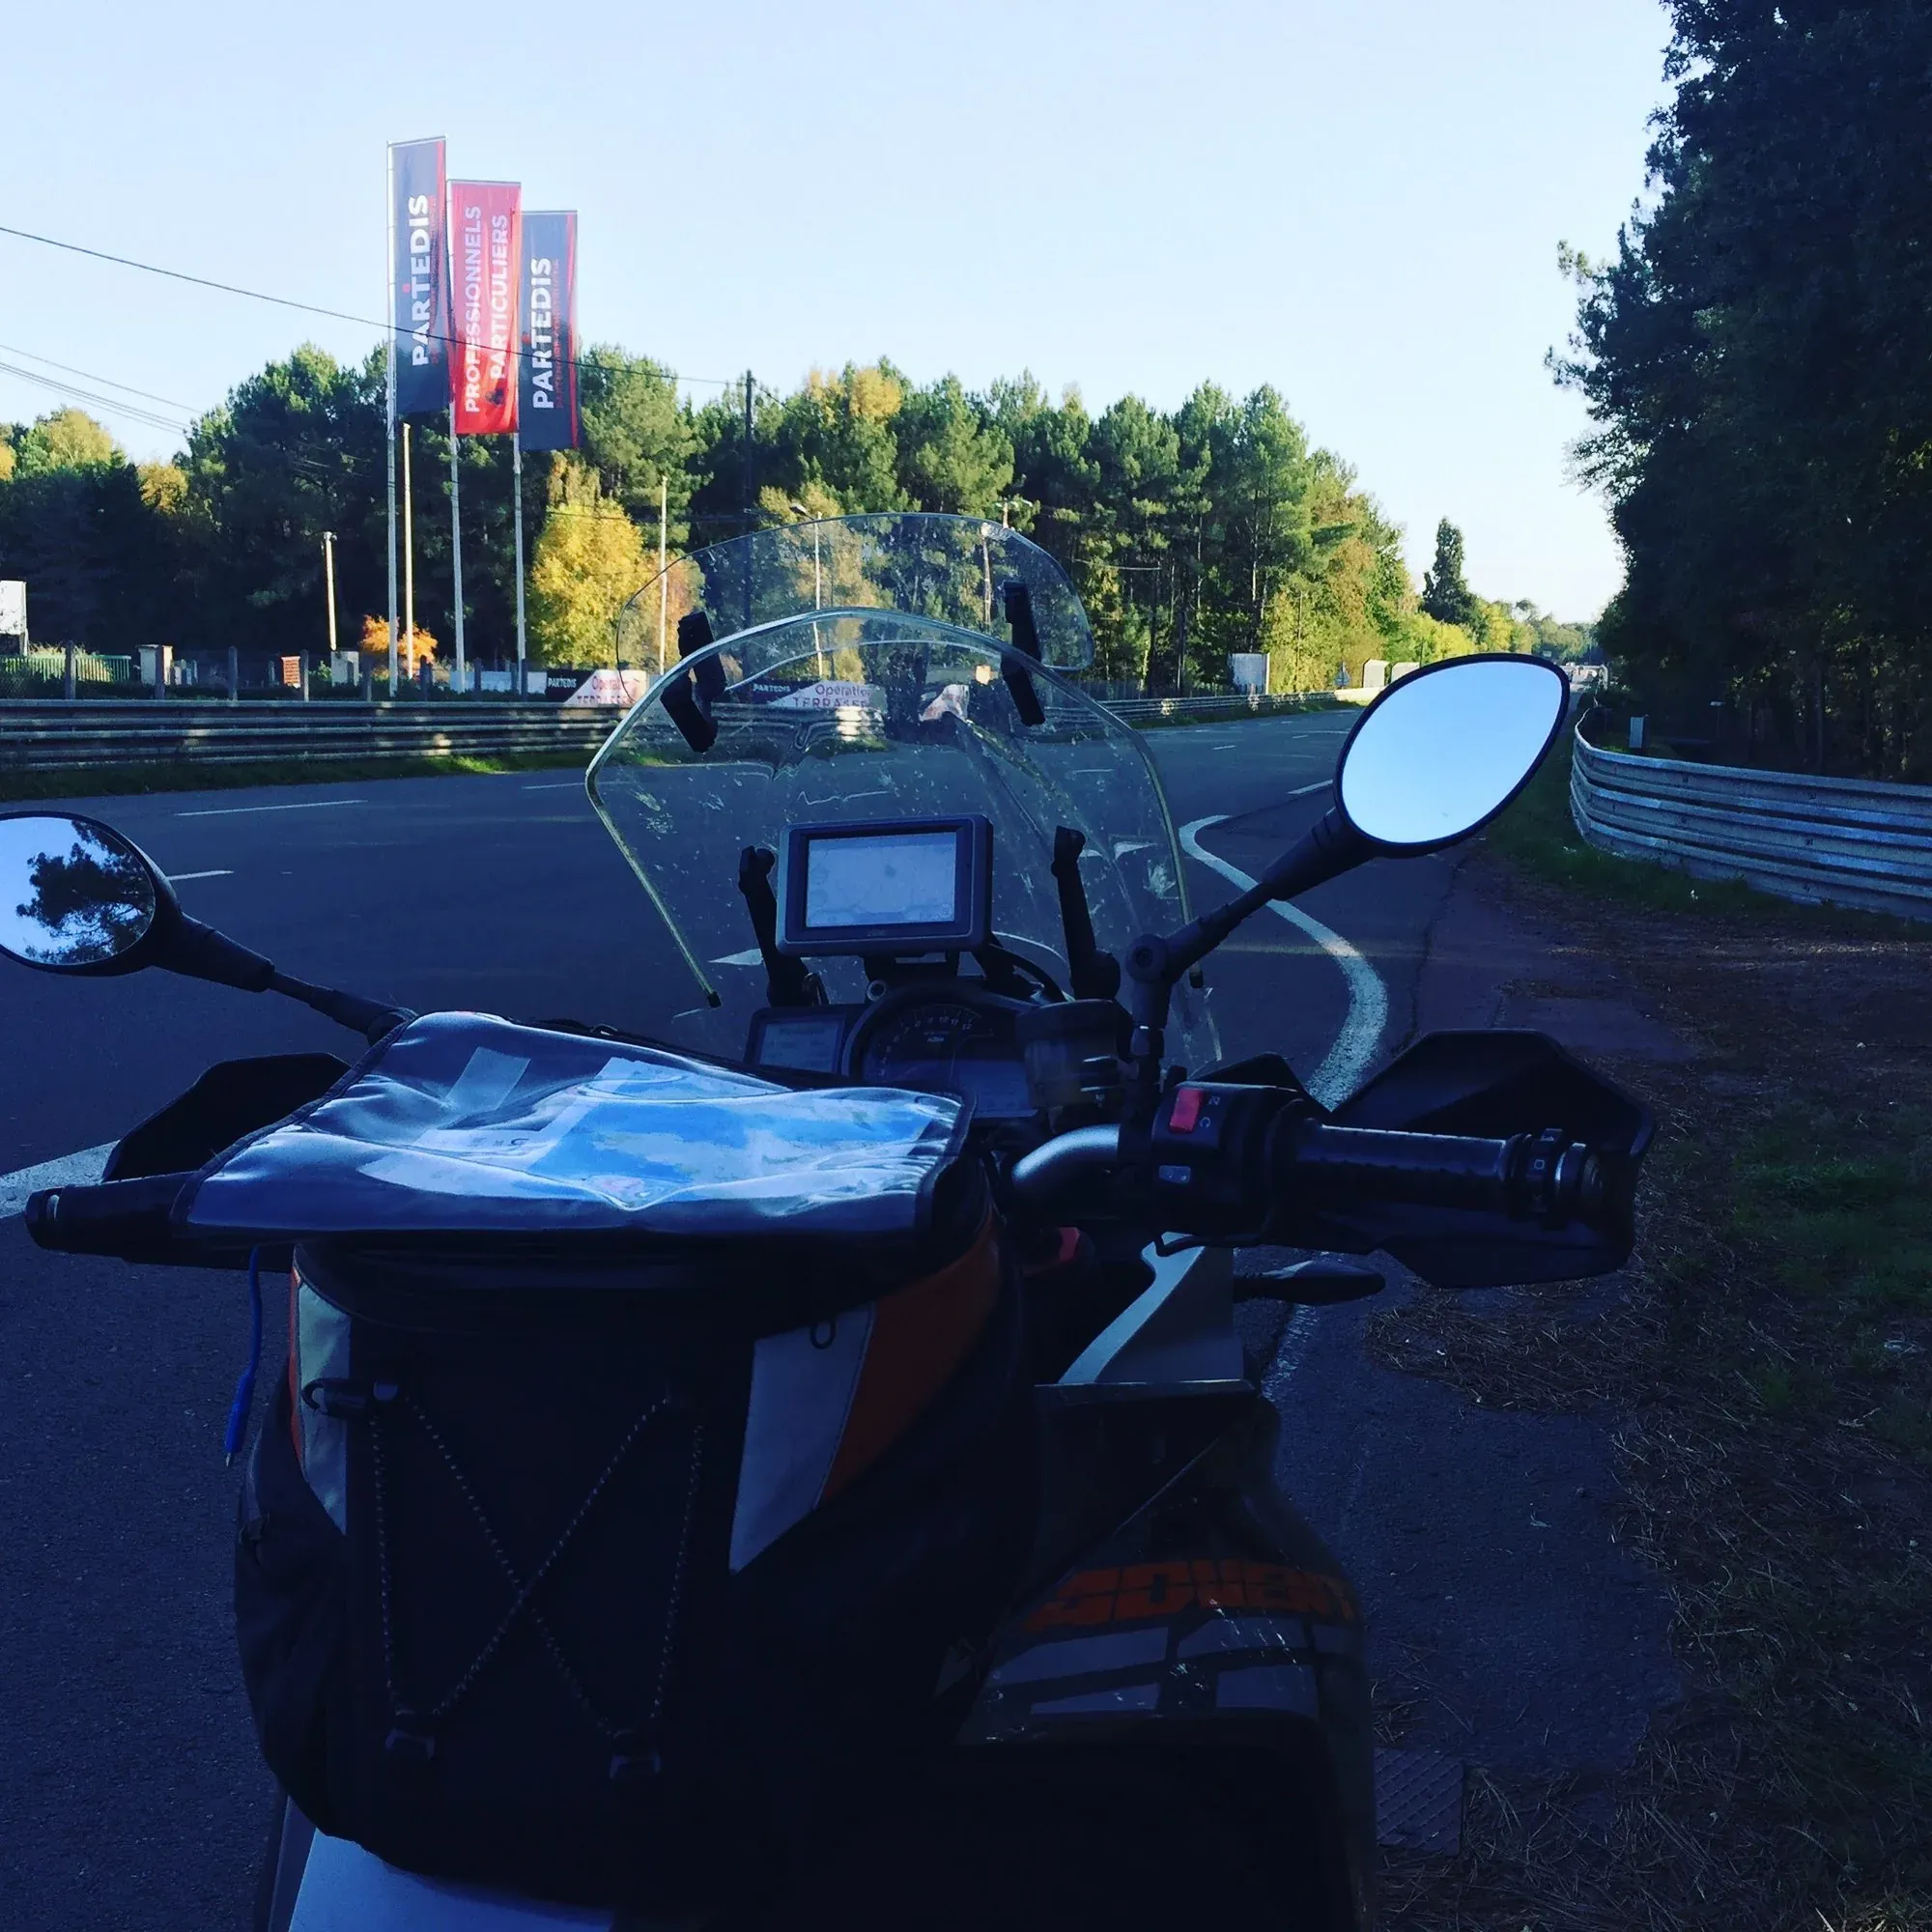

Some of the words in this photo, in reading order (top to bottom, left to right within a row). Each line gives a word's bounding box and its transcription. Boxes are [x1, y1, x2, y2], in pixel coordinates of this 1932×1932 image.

[408, 194, 432, 366] PARTEDIS
[465, 205, 482, 413] PROFESSIONNELS
[490, 213, 509, 381] PARTICULIERS
[530, 257, 555, 409] PARTEDIS
